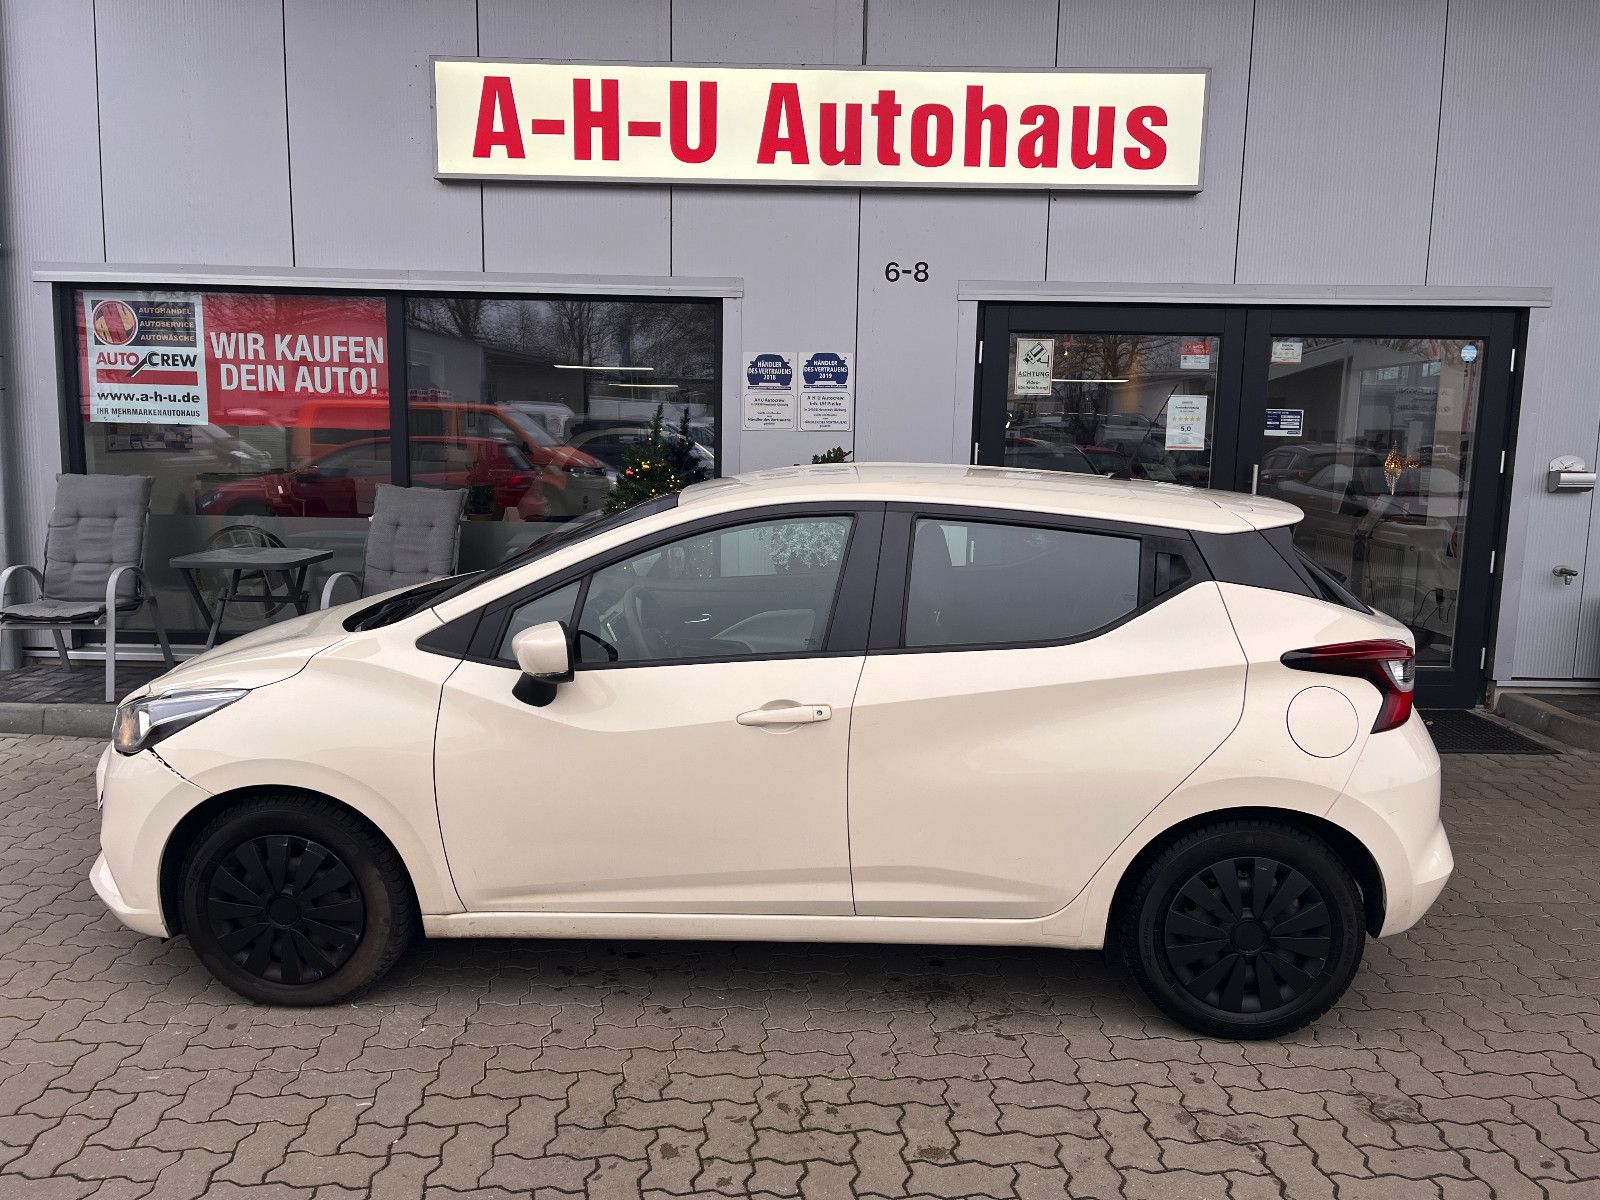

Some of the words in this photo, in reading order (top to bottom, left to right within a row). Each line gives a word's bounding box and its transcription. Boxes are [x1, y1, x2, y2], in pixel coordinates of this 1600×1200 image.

[472, 76, 718, 164] A-H-U
[757, 81, 1168, 171] Autohaus
[885, 262, 929, 282] 6-8
[138, 307, 191, 315] AUTOHANDEL
[140, 321, 195, 329] AUTOSERVICE
[210, 331, 266, 361] WIR
[275, 333, 384, 364] KAUFEN
[96, 351, 140, 366] AUTO
[147, 351, 198, 368] CREW
[220, 363, 286, 392] DEIN
[294, 365, 378, 395] AUTO!
[97, 391, 201, 403] www.a-h-u.de
[96, 407, 109, 415] IHR
[111, 408, 201, 417] MEHRMARKENAUTOHAUS
